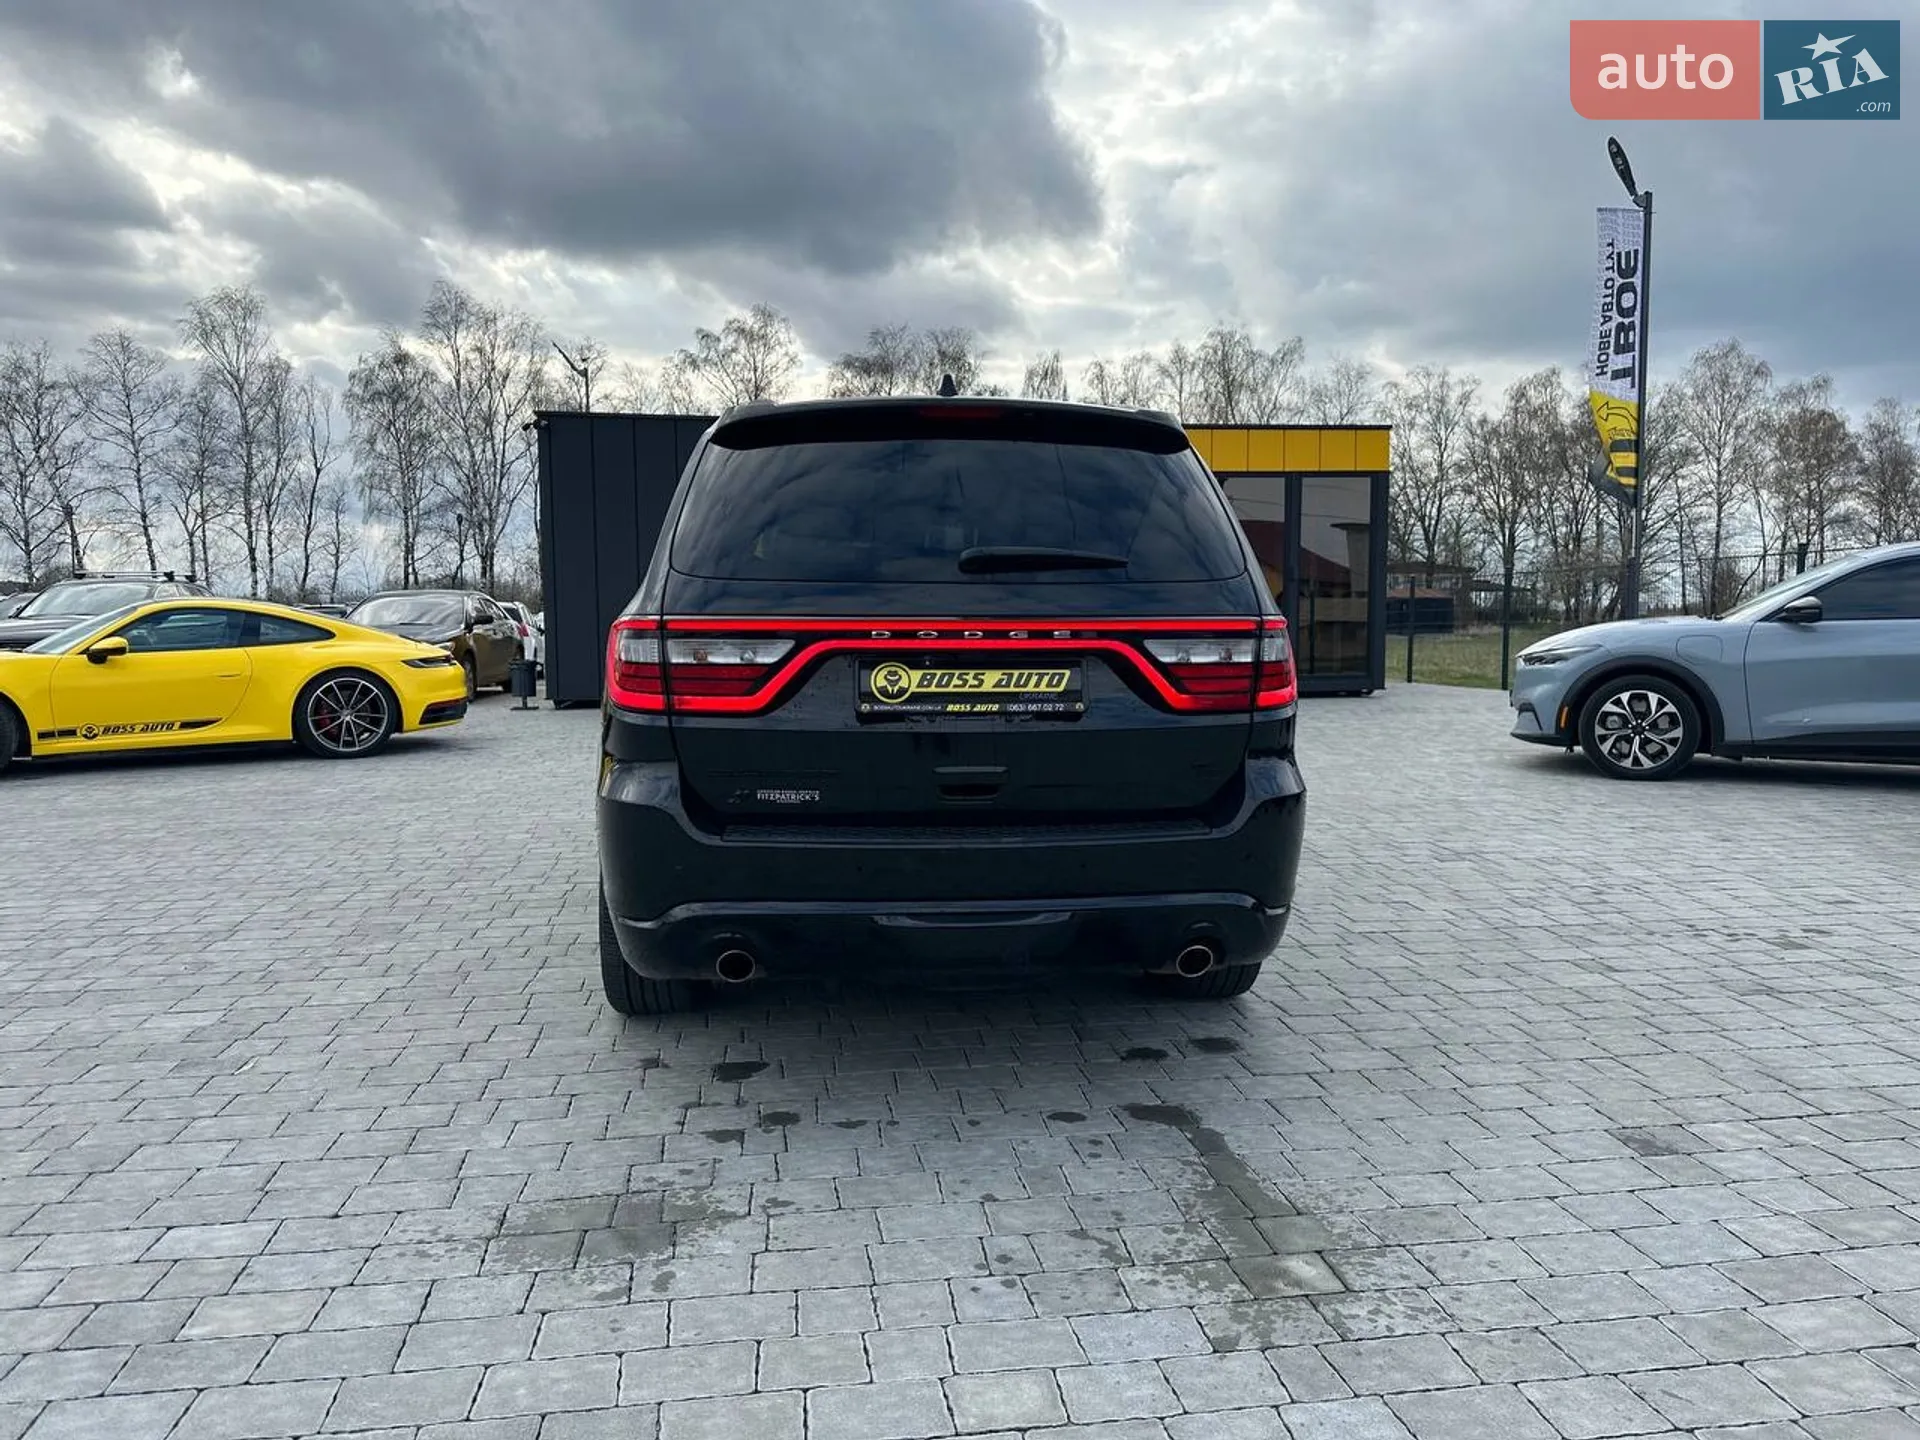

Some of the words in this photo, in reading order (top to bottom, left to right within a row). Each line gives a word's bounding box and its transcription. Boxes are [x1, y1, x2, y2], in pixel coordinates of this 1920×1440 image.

[871, 630, 1072, 639] DODGE
[916, 672, 986, 689] BOSS
[992, 672, 1067, 689] AUTO
[946, 703, 971, 712] BOSS
[973, 703, 999, 712] AUTO
[102, 725, 136, 735] BOSS
[140, 722, 174, 732] AUTO
[757, 793, 820, 801] FITZPATRICK'S
